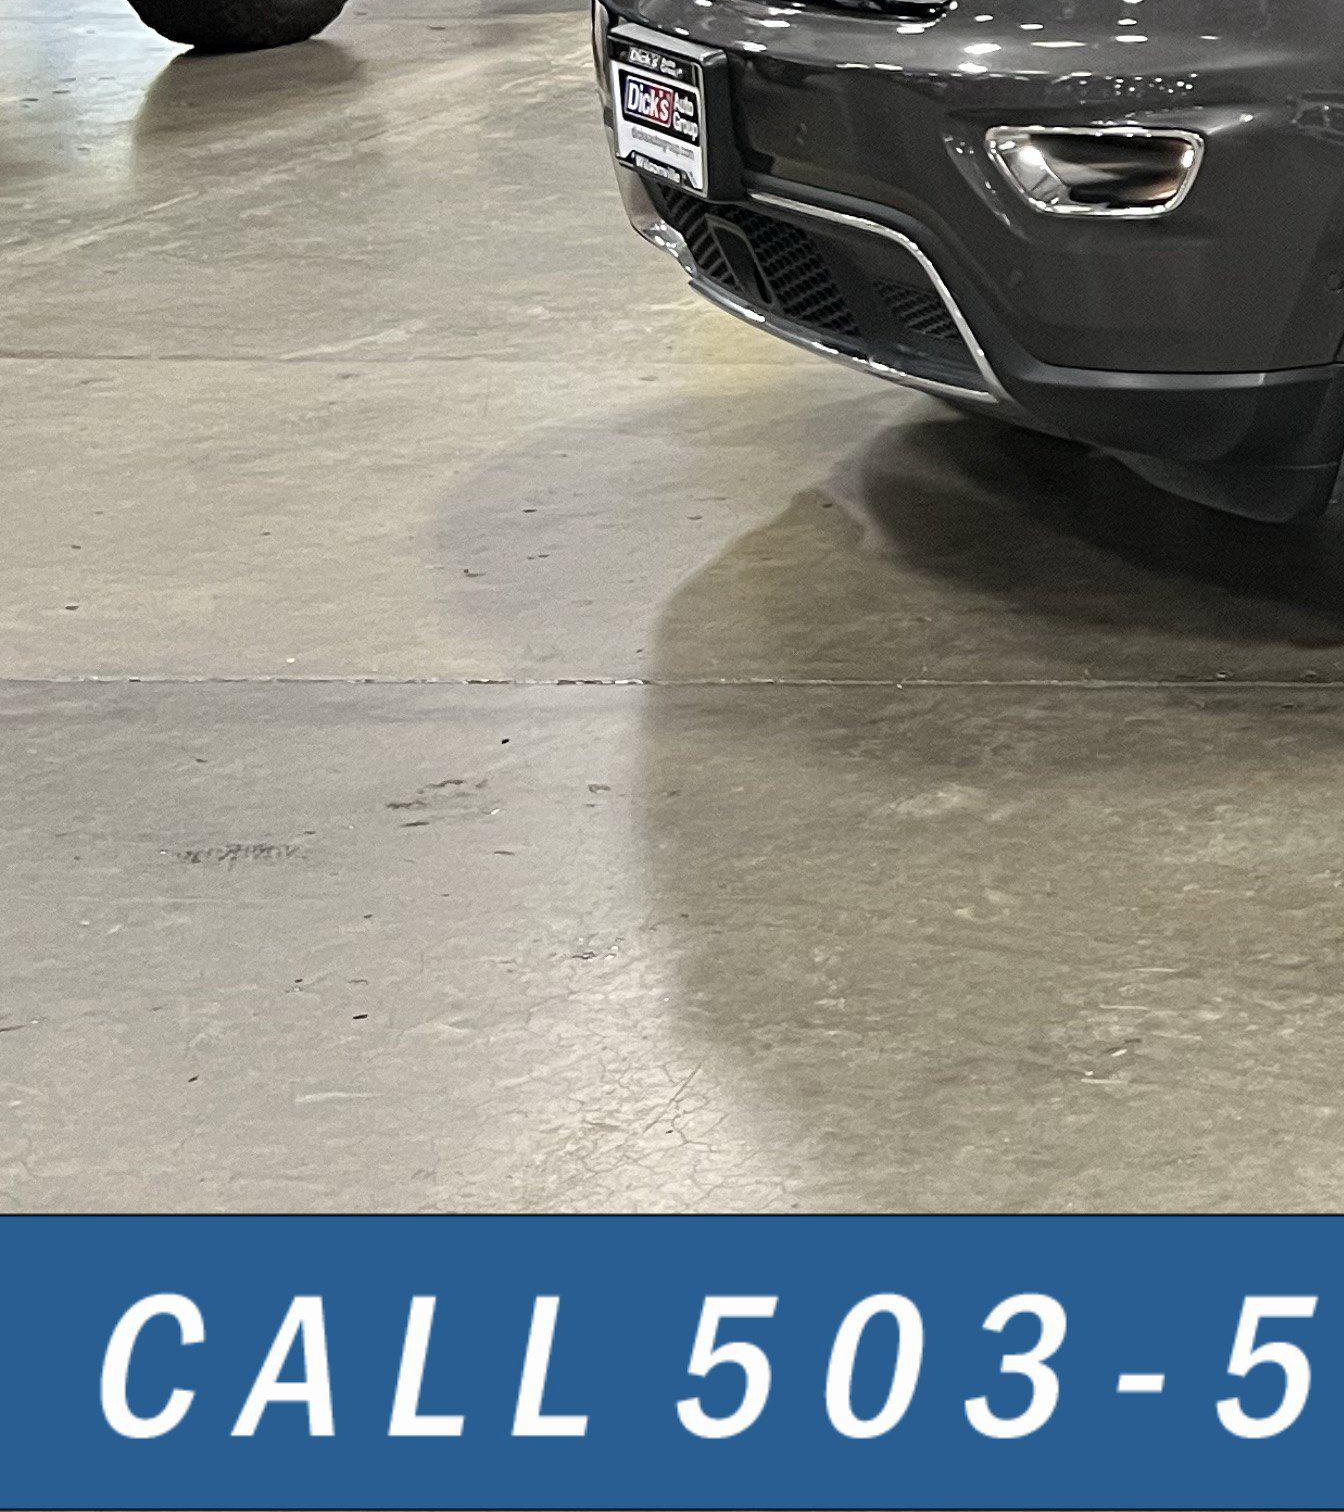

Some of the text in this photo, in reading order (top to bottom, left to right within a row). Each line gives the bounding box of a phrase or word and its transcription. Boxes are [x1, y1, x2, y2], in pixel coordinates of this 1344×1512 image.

[627, 81, 695, 122] Dick's Auto
[673, 113, 699, 141] Group
